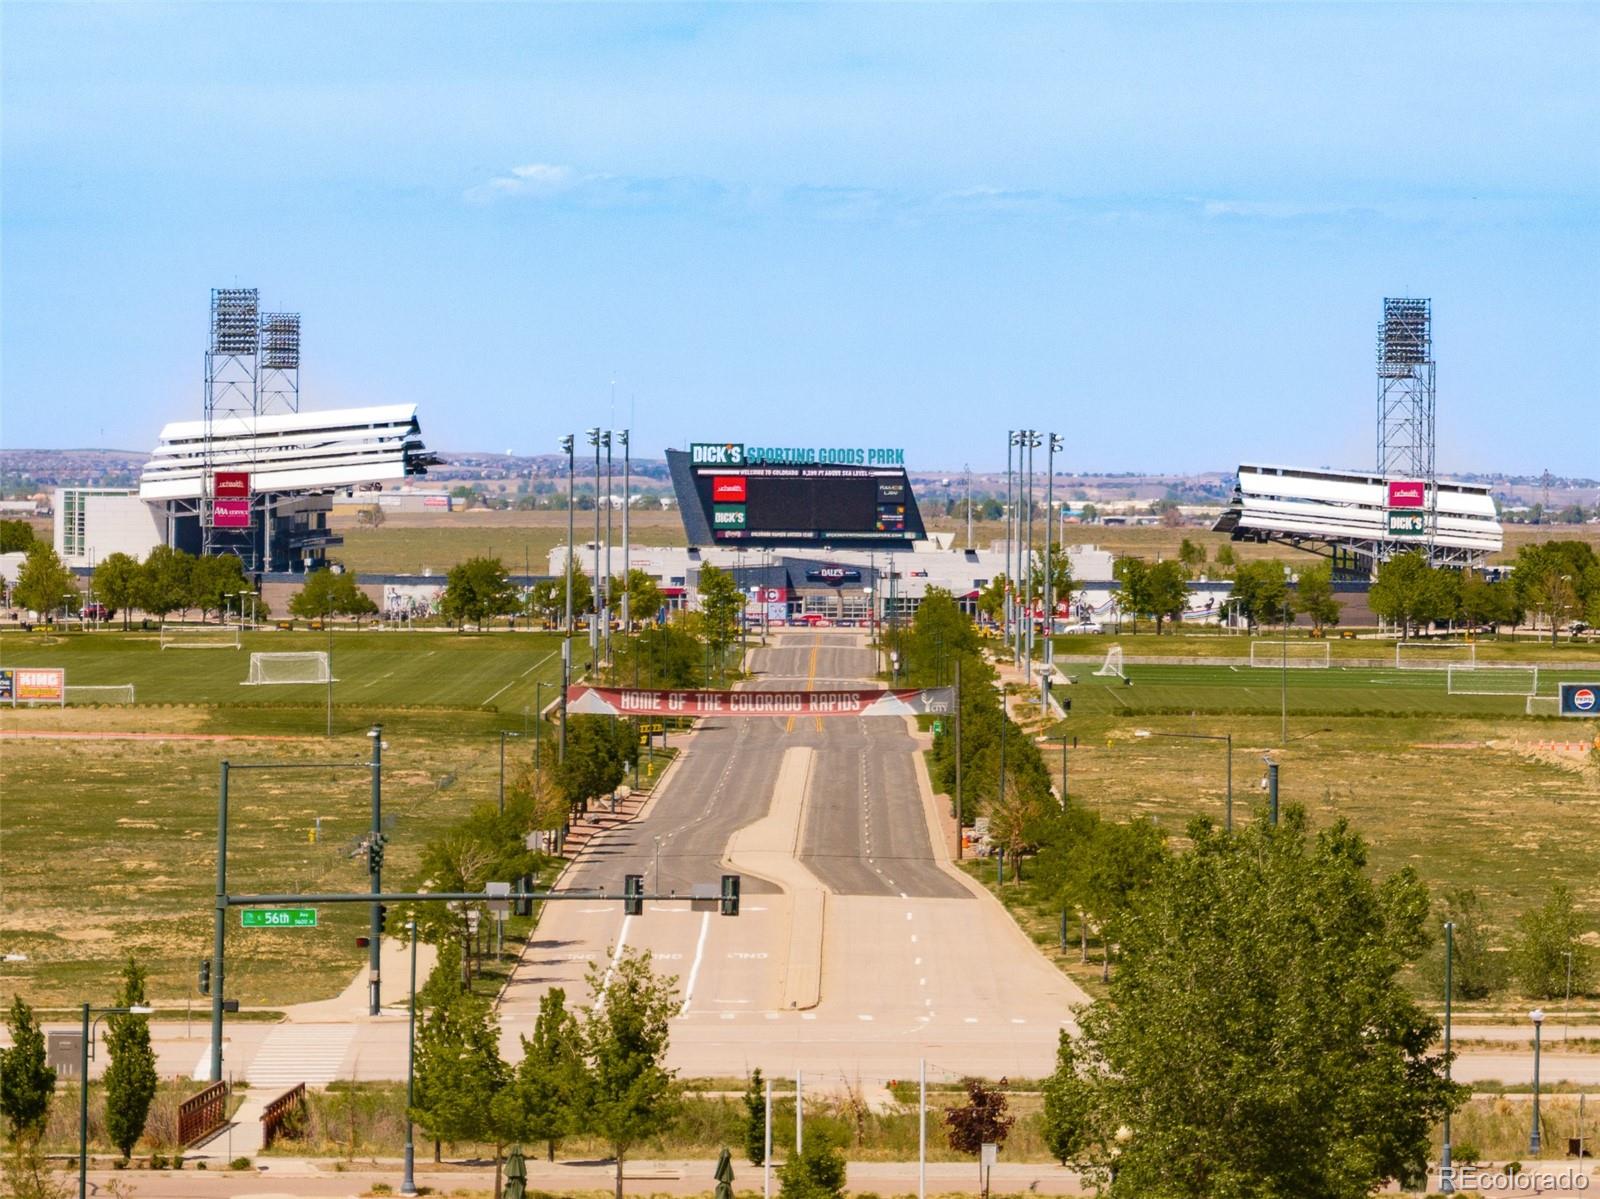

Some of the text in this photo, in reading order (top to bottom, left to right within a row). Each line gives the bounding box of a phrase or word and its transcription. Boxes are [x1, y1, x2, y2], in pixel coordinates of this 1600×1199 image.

[693, 446, 905, 465] DICK'S SPORTING GOODS PARK
[714, 512, 744, 523] DICK'S
[1390, 515, 1422, 530] DICK'S
[620, 691, 860, 712] HOME OF THE COLORADO RAPIDS
[931, 704, 948, 712] CITY
[264, 912, 290, 924] 56th
